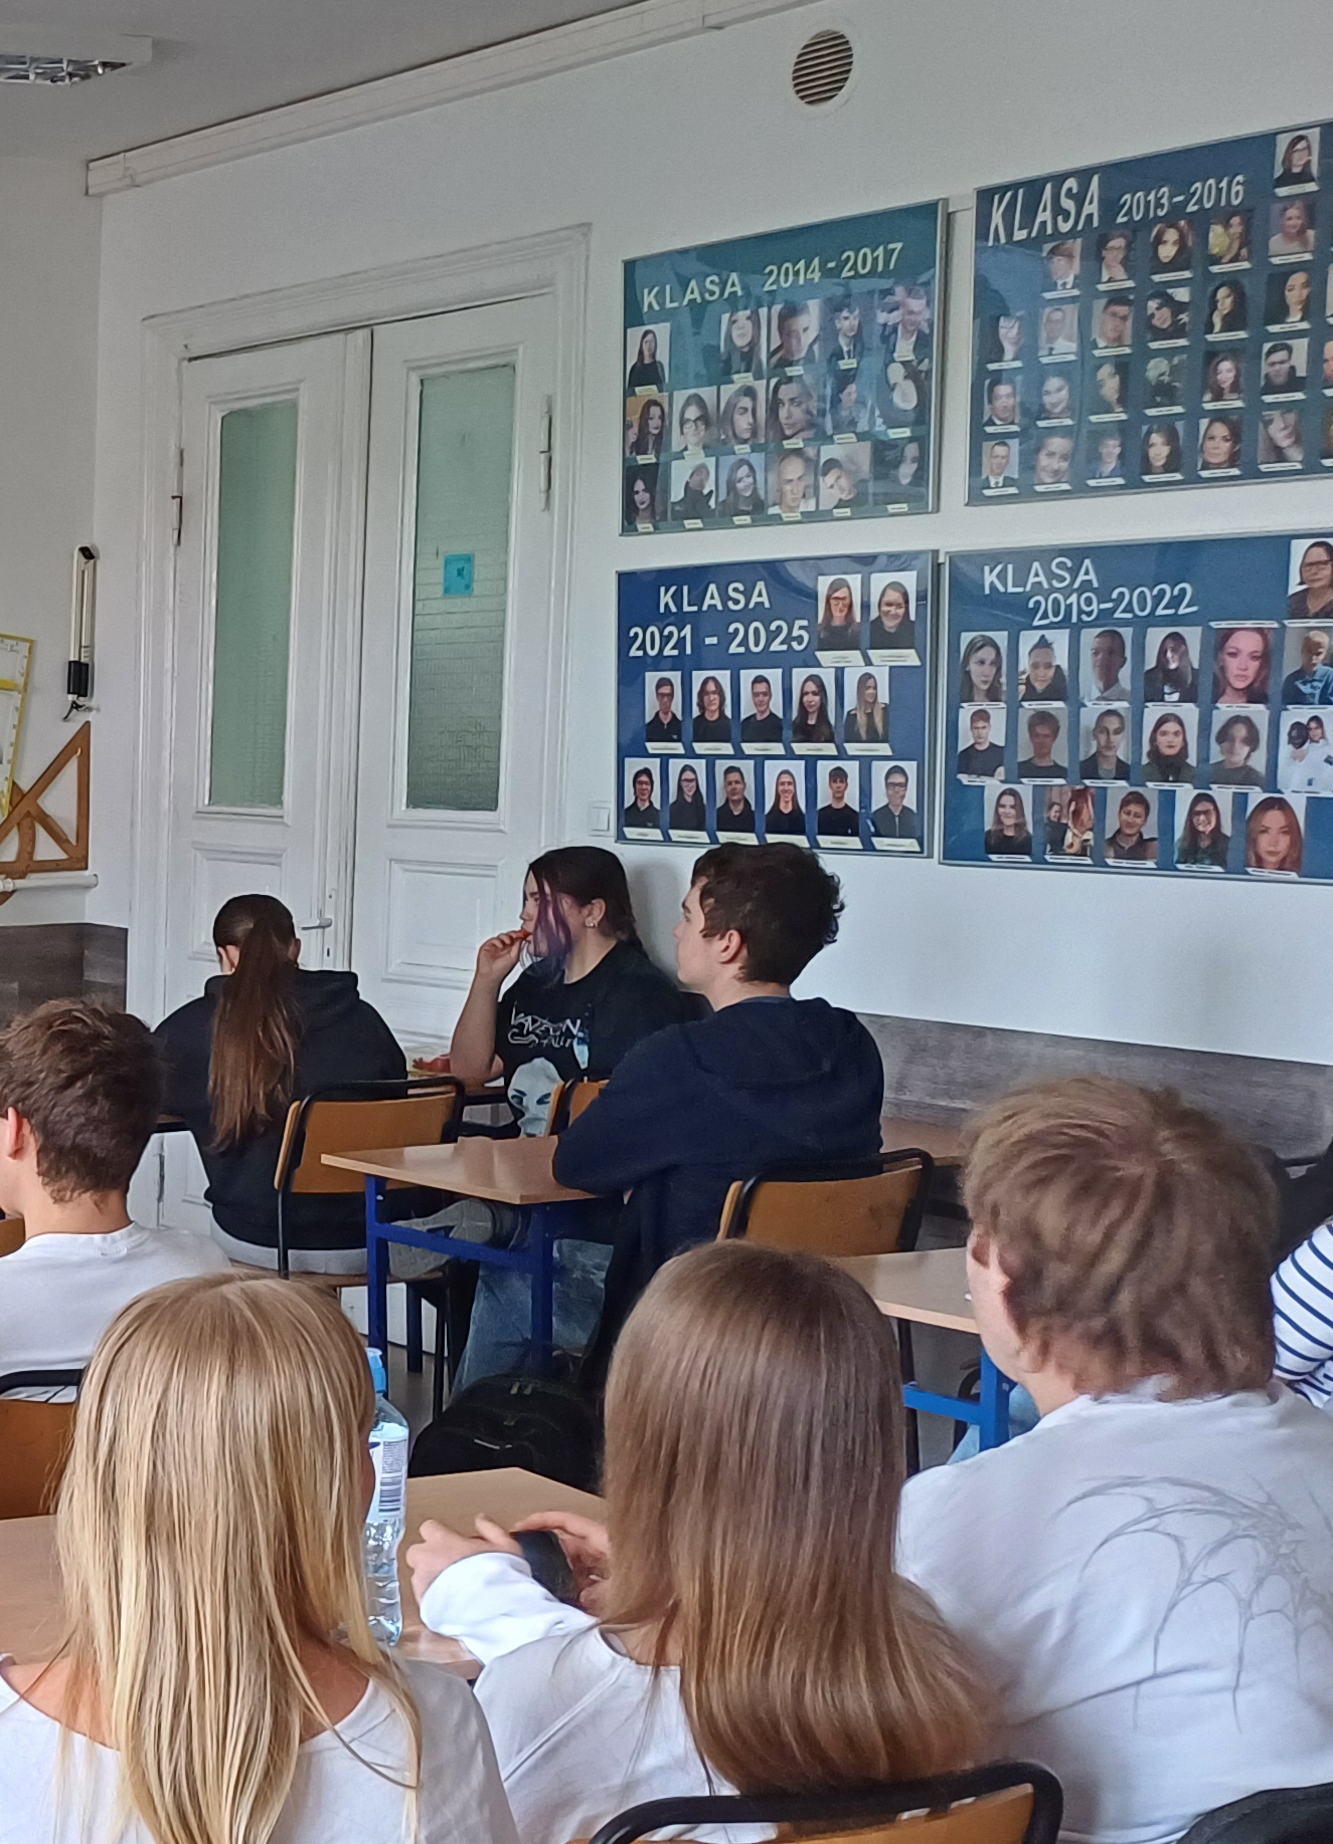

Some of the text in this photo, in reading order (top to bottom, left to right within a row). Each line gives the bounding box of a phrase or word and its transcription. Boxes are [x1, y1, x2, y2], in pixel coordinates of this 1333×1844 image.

[987, 173, 1246, 247] KLASA 2013-2016
[642, 271, 744, 314] KLASA
[983, 556, 1099, 595] KLASA
[659, 580, 771, 614] KLASA
[1027, 582, 1200, 627] 2019-2022
[628, 623, 693, 657] 2021
[727, 619, 810, 655] 2025
